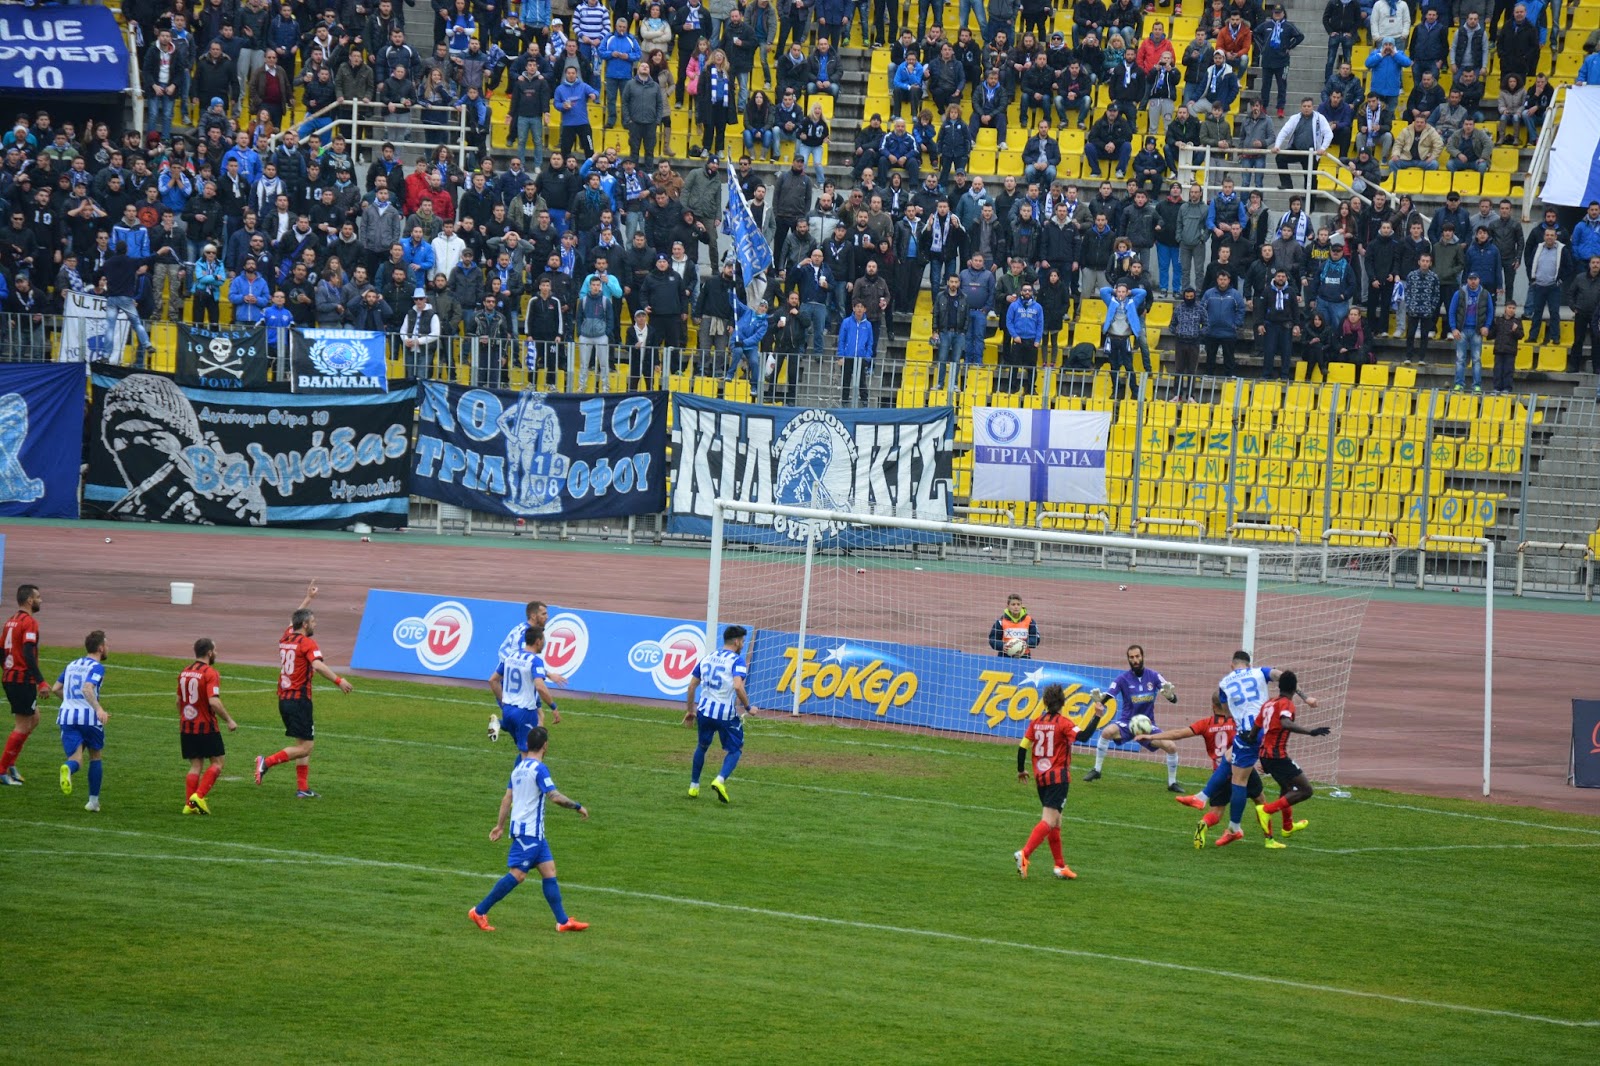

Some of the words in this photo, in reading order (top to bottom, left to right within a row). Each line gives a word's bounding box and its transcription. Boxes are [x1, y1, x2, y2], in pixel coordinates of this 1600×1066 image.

[0, 18, 84, 41] LUE
[13, 65, 64, 89] 10
[306, 187, 322, 200] 10
[34, 210, 52, 225] 10
[190, 327, 252, 340] EDESSA
[200, 376, 244, 388] TOWN
[311, 410, 330, 426] 10
[576, 396, 654, 446] 10
[987, 447, 1092, 466] ΤΡΙΑΝΔΡΙΑ
[4, 627, 13, 652] 4
[430, 624, 462, 647] TV
[667, 647, 698, 670] TV
[66, 674, 85, 700] 12
[505, 666, 522, 694] 19
[702, 662, 726, 690] 25
[179, 676, 199, 704] 19
[1226, 676, 1261, 707] 33
[1034, 730, 1055, 757] 21
[1214, 730, 1229, 757] 9
